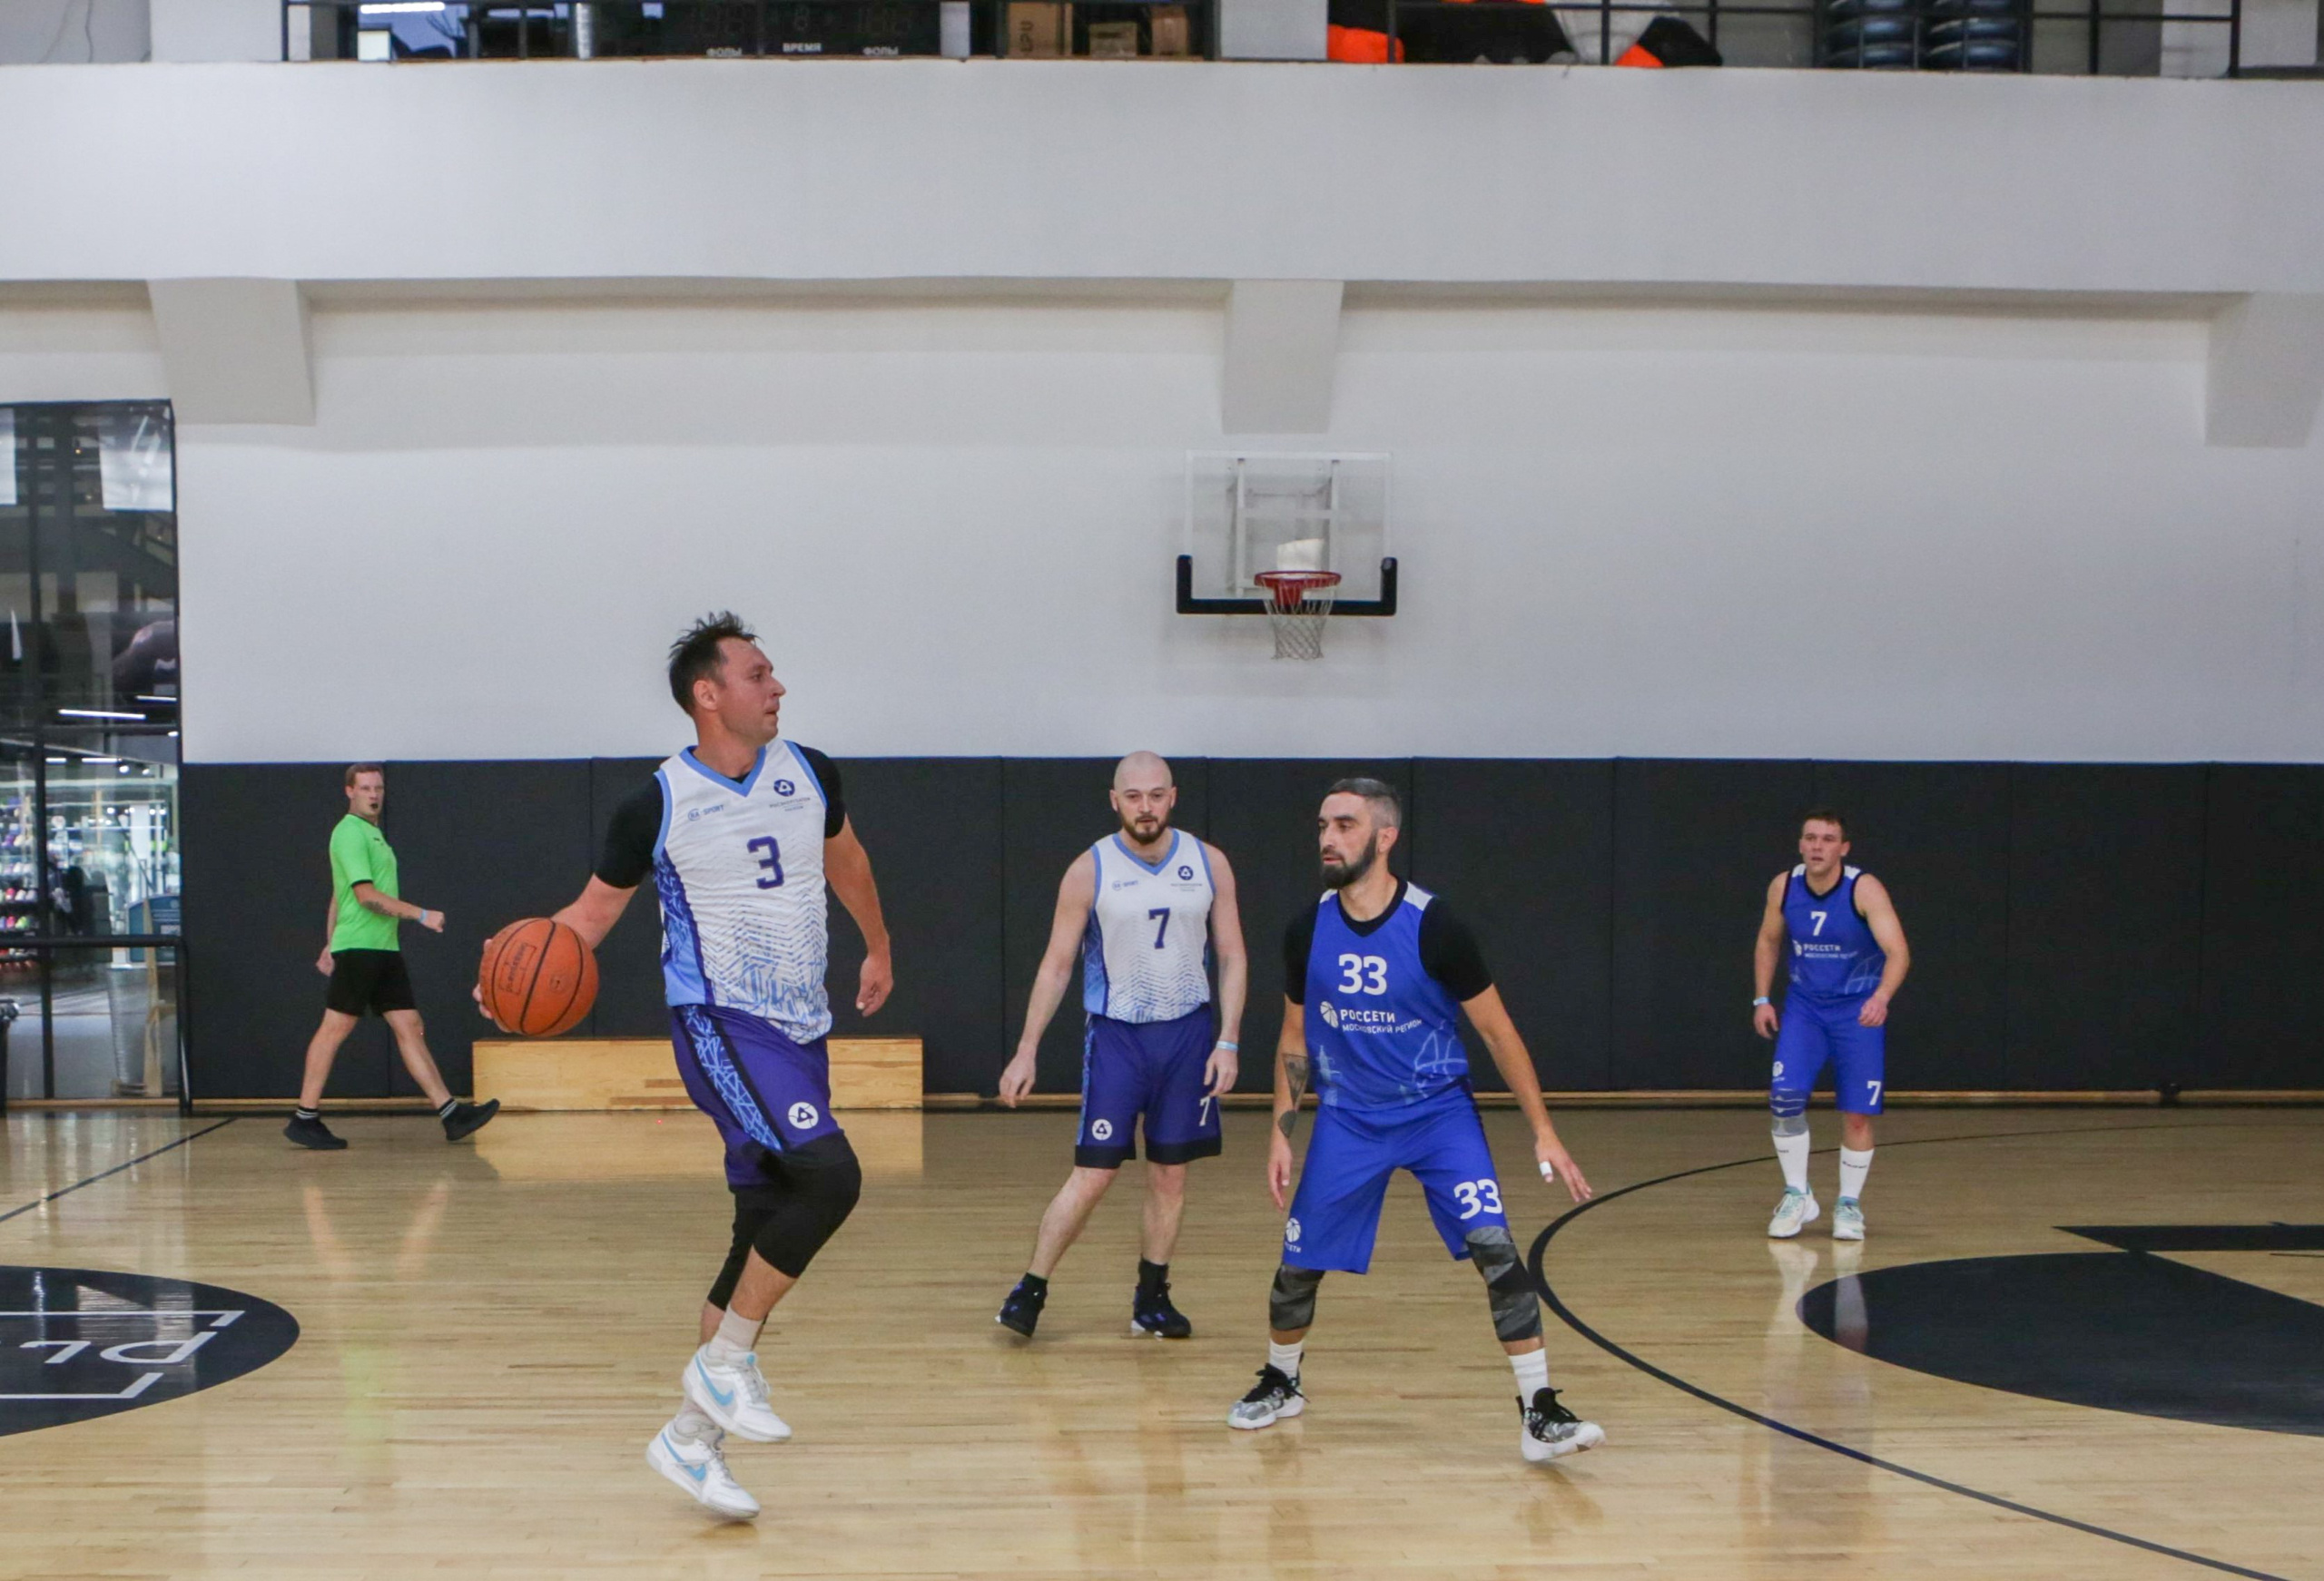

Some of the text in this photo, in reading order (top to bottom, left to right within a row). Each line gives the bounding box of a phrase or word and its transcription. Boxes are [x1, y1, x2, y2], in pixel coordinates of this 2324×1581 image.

[783, 42, 822, 53] ВРЕМЯ
[746, 835, 784, 889] 3
[1148, 908, 1170, 949] 7
[1810, 911, 1827, 937] 7
[1338, 953, 1388, 996] 33
[1340, 1008, 1396, 1023] РОССЕТИ
[1342, 1018, 1423, 1035] МОСКОВСКИЙ РЕГИОН
[1866, 1080, 1882, 1105] 7
[1198, 1096, 1210, 1126] 7
[1453, 1178, 1503, 1220] 33
